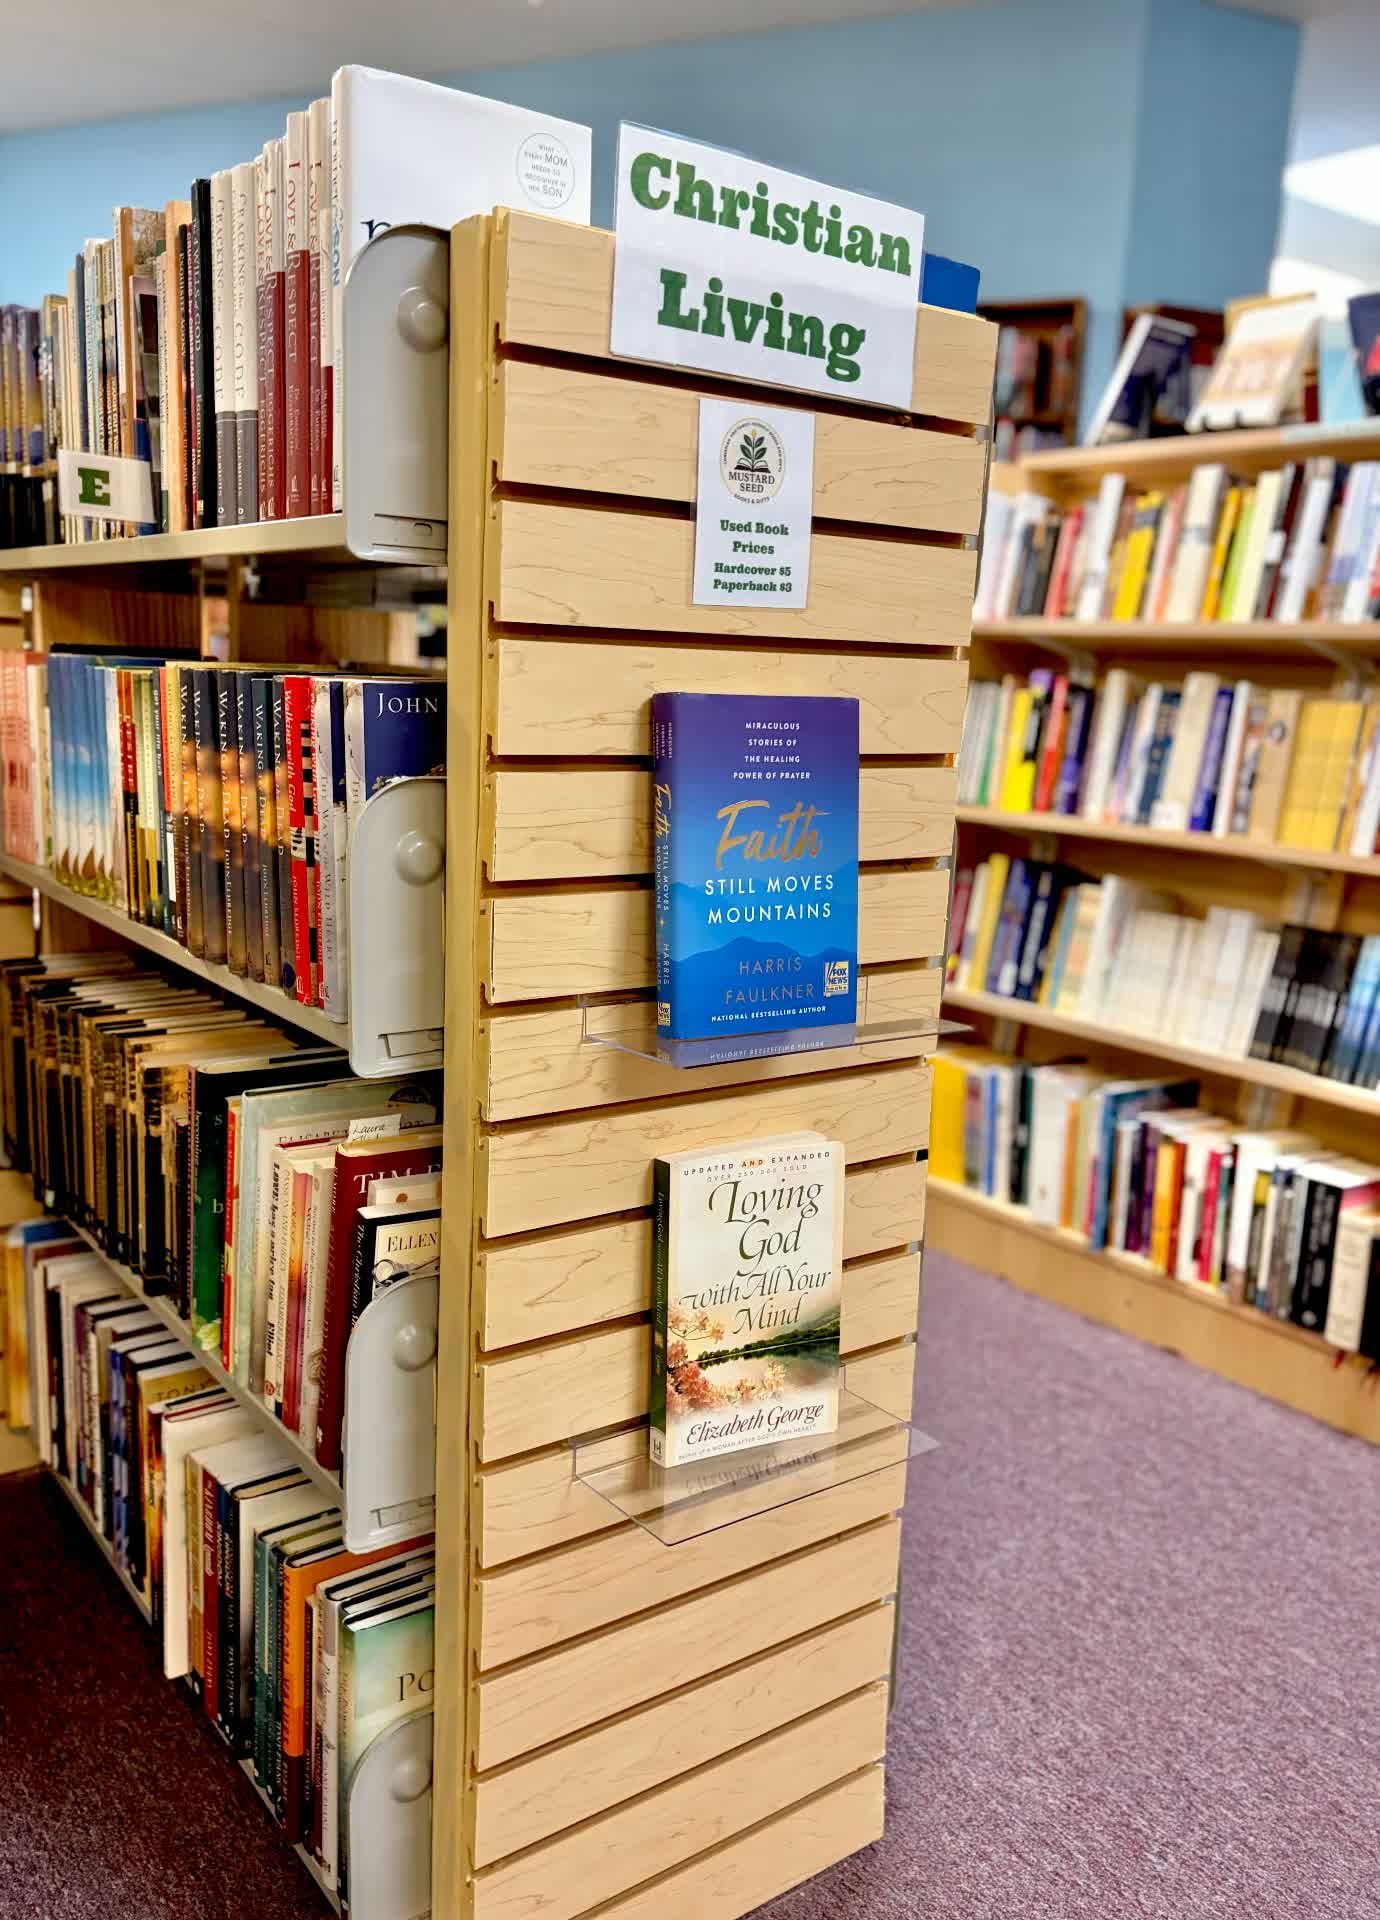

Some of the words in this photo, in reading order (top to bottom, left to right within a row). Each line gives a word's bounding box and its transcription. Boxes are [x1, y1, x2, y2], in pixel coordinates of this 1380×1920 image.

[544, 153, 568, 167] MOM
[288, 162, 301, 227] LOVE
[542, 185, 562, 199] SON
[265, 190, 276, 248] LOVE
[630, 152, 911, 277] Christian
[215, 200, 224, 288] CRACKING
[238, 193, 248, 289] CRACKING
[332, 228, 341, 288] SON
[264, 274, 277, 380] RESPECT
[287, 253, 301, 363] RESPECT
[310, 256, 320, 368] RESPECT
[657, 269, 866, 384] Living
[77, 466, 112, 507] E
[728, 471, 775, 485] MUSTARD
[739, 483, 764, 493] SEED
[720, 519, 752, 533] Used
[755, 522, 789, 535] Book
[732, 540, 775, 554] Prices
[713, 579, 777, 593] Paperback
[779, 582, 792, 592] $3
[714, 562, 777, 576] Hardcover
[779, 566, 791, 576] $5
[284, 688, 293, 746] Walking
[376, 692, 438, 719] JOHN
[219, 691, 228, 765] WAKING
[256, 703, 264, 771] WAKING
[273, 698, 282, 777] WAKING
[745, 722, 800, 730] MIRACULOUS
[286, 749, 296, 780] with
[222, 791, 230, 838] DEAD
[259, 796, 267, 837] DEAD
[288, 782, 297, 813] God
[240, 796, 248, 845] DEAD
[276, 806, 285, 857] DEAD
[321, 808, 329, 839] WAY
[715, 799, 832, 871] Faith
[705, 878, 756, 896] STILL
[766, 874, 834, 893] MOVES
[707, 902, 832, 925] MOUNTAINS
[738, 956, 802, 975] HARRIS
[829, 977, 848, 985] NEWS
[831, 967, 848, 976] FOX
[711, 1012, 748, 1023] NATIONAL
[751, 1008, 796, 1019] BESTSELLING
[798, 1005, 826, 1014] AUTHOR
[725, 983, 814, 1005] FAULKNER
[272, 1161, 281, 1201] LOVE
[683, 1163, 735, 1176] UPDATED
[741, 1158, 764, 1168] AND
[771, 1151, 831, 1164] EXPANDED
[708, 1178, 825, 1224] Loving
[357, 1223, 365, 1247] The
[387, 1231, 439, 1253] ELLEN
[736, 1214, 804, 1274] God
[269, 1239, 278, 1275] price
[352, 1250, 363, 1309] Christian
[679, 1278, 741, 1310] with
[742, 1264, 787, 1300] All
[783, 1262, 832, 1292] Your
[732, 1292, 809, 1335] Mind
[266, 1320, 275, 1357] Elliot
[686, 1409, 765, 1445] Elizabeth
[767, 1403, 825, 1433] George
